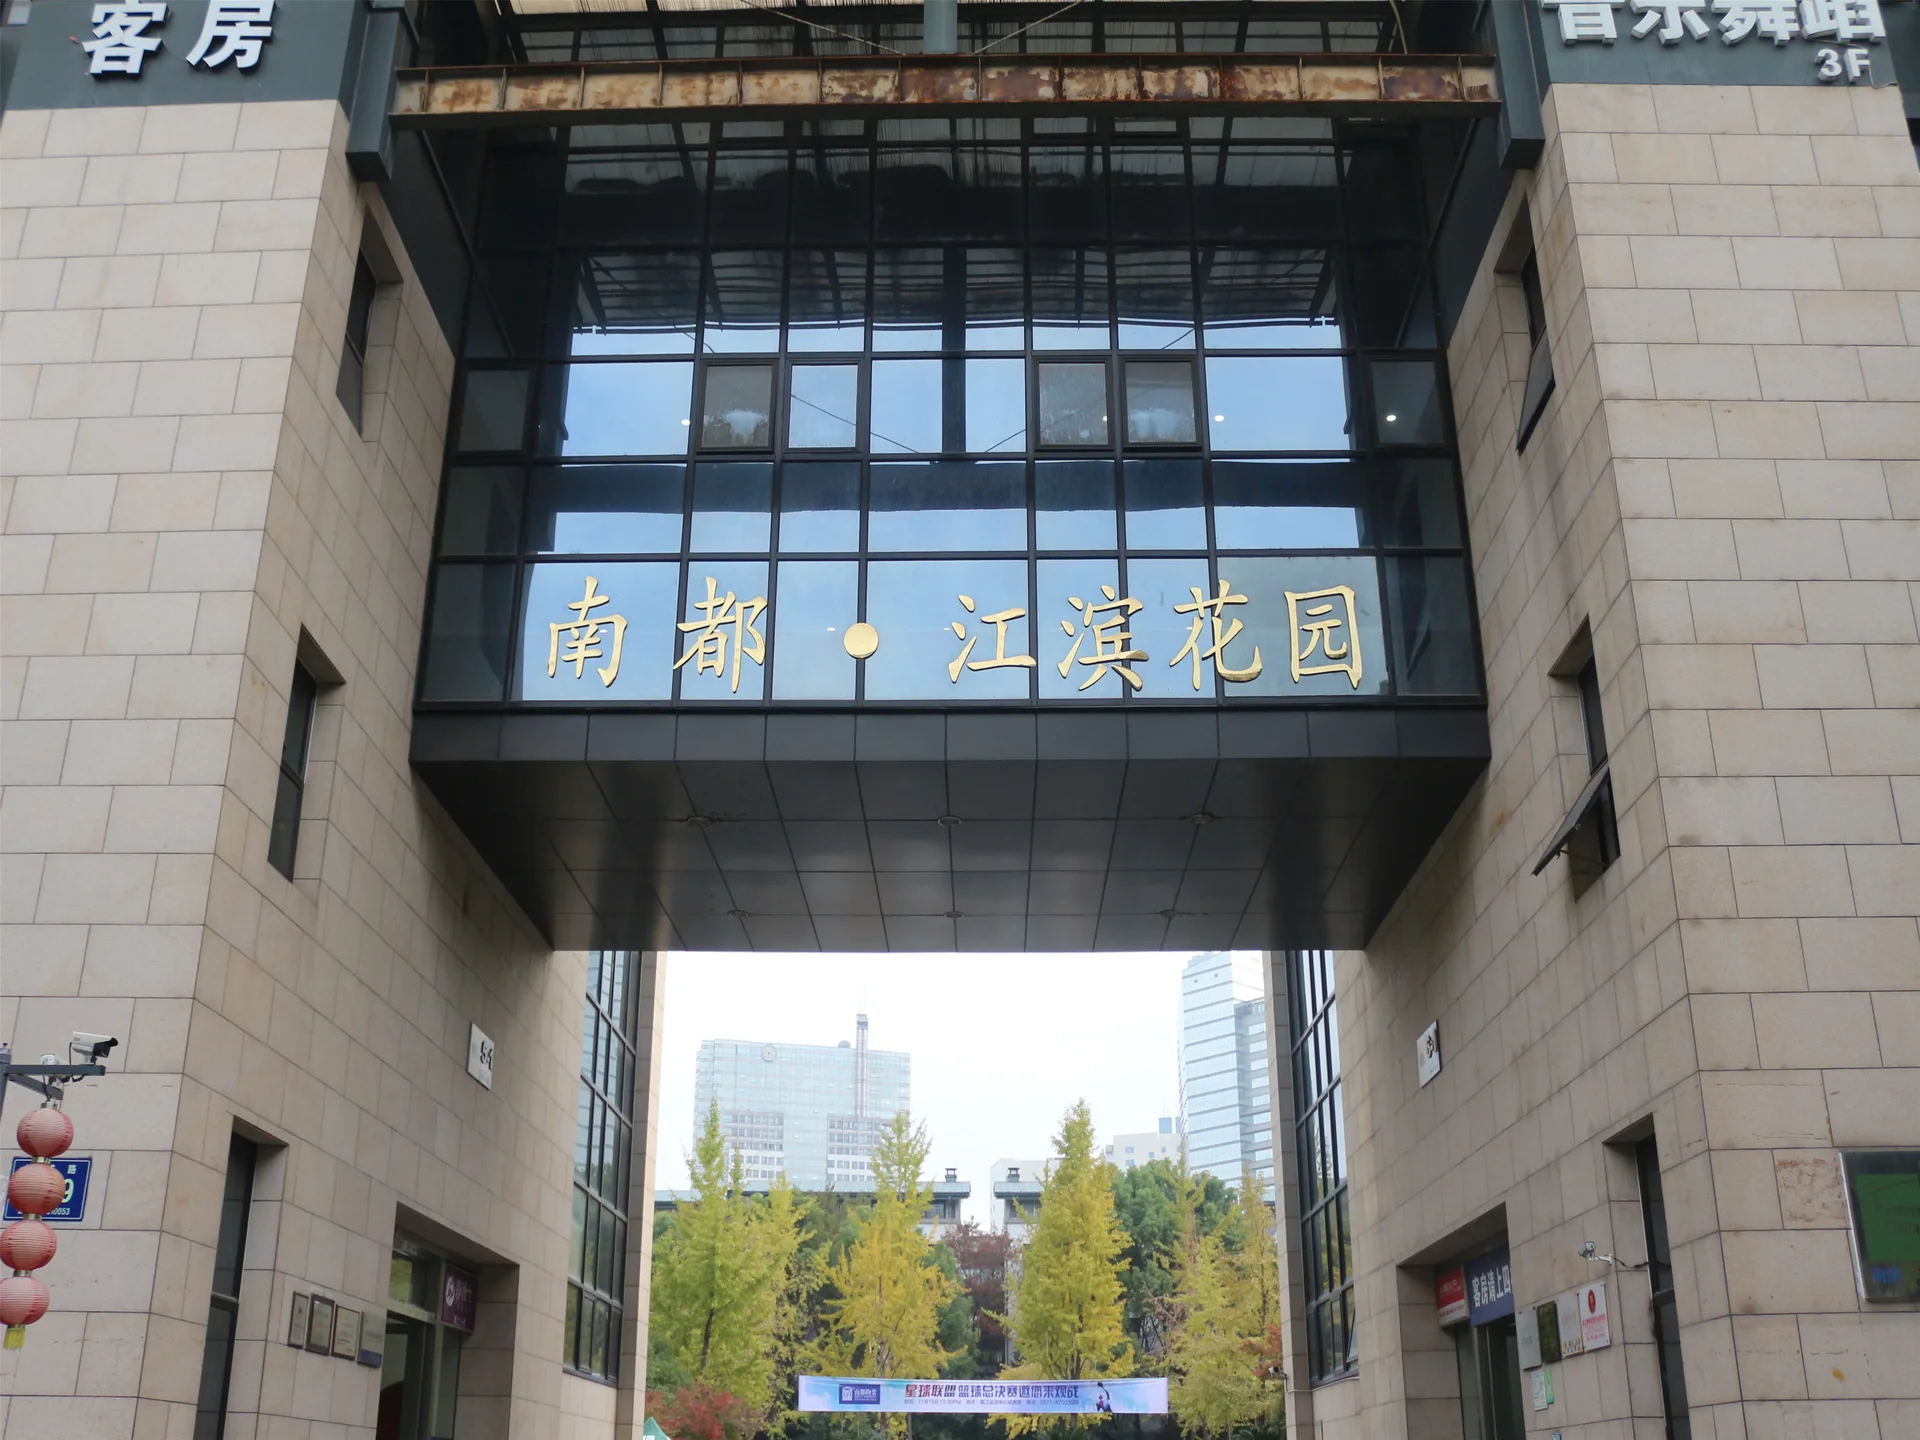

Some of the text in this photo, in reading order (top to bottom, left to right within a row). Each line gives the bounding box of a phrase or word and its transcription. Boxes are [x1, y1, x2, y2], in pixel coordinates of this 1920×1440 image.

[82, 0, 278, 77] 客房
[1814, 47, 1871, 82] 3F
[1472, 1265, 1512, 1309] 客房请上四
